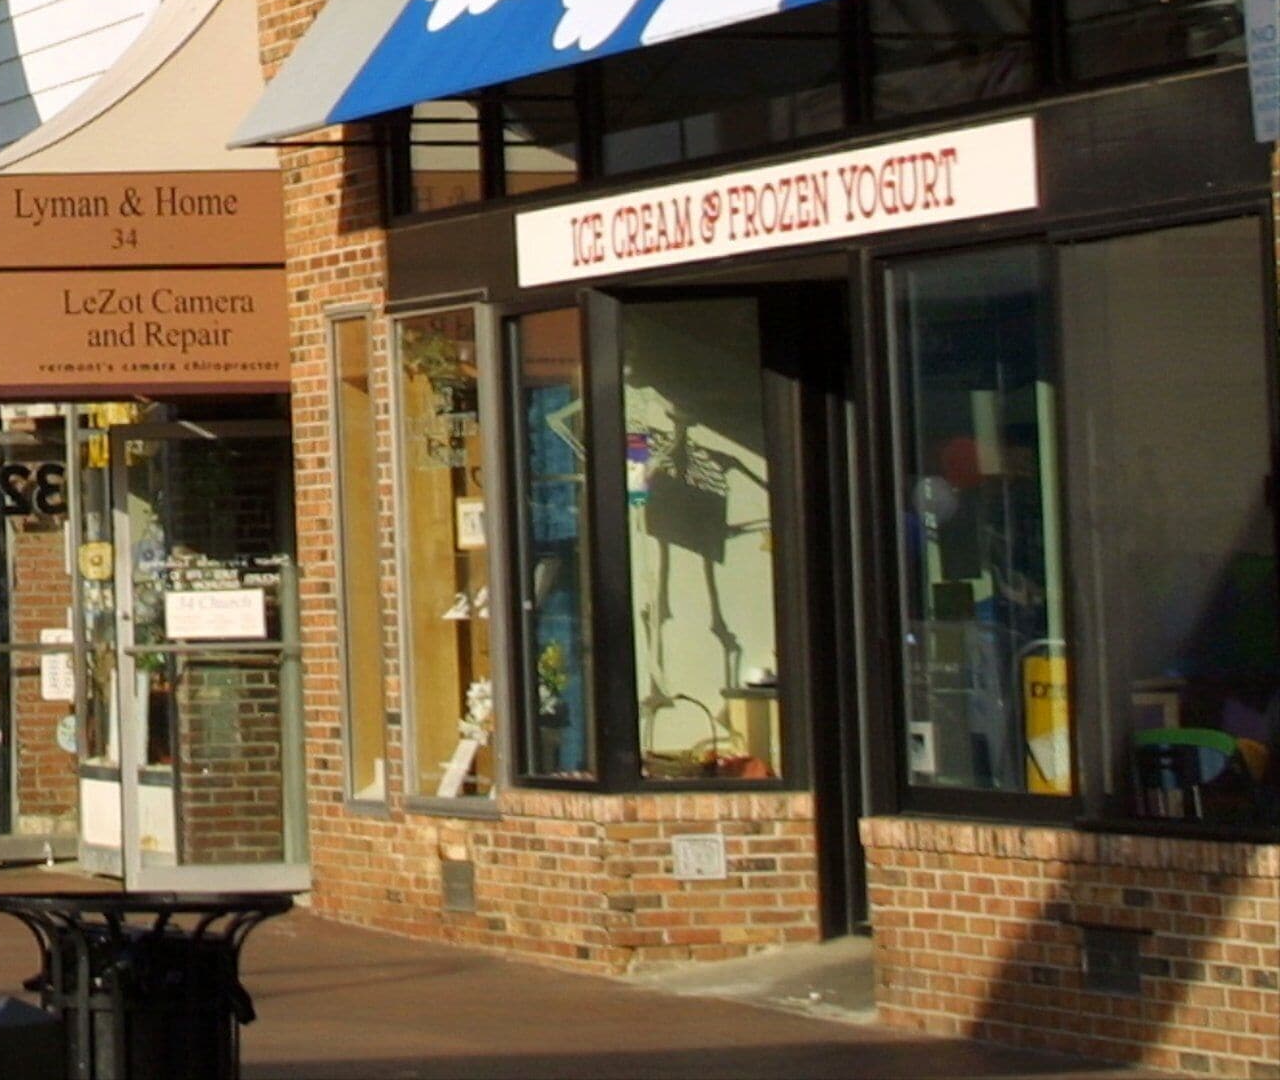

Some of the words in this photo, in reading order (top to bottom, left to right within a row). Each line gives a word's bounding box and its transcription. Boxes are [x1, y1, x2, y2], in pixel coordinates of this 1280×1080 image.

[14, 188, 109, 226] Lyman
[120, 187, 142, 217] &
[155, 186, 238, 217] Home
[570, 213, 605, 267] ICE
[611, 197, 695, 259] CREAM
[700, 189, 722, 243] &
[728, 170, 831, 240] FROZEN
[838, 148, 957, 221] YOGURT
[111, 228, 139, 250] 34
[63, 289, 141, 315] LeZot
[152, 289, 254, 314] Camera
[87, 322, 135, 347] and
[144, 322, 231, 354] Repair
[122, 361, 176, 371] camera
[183, 359, 280, 372] chiropractor
